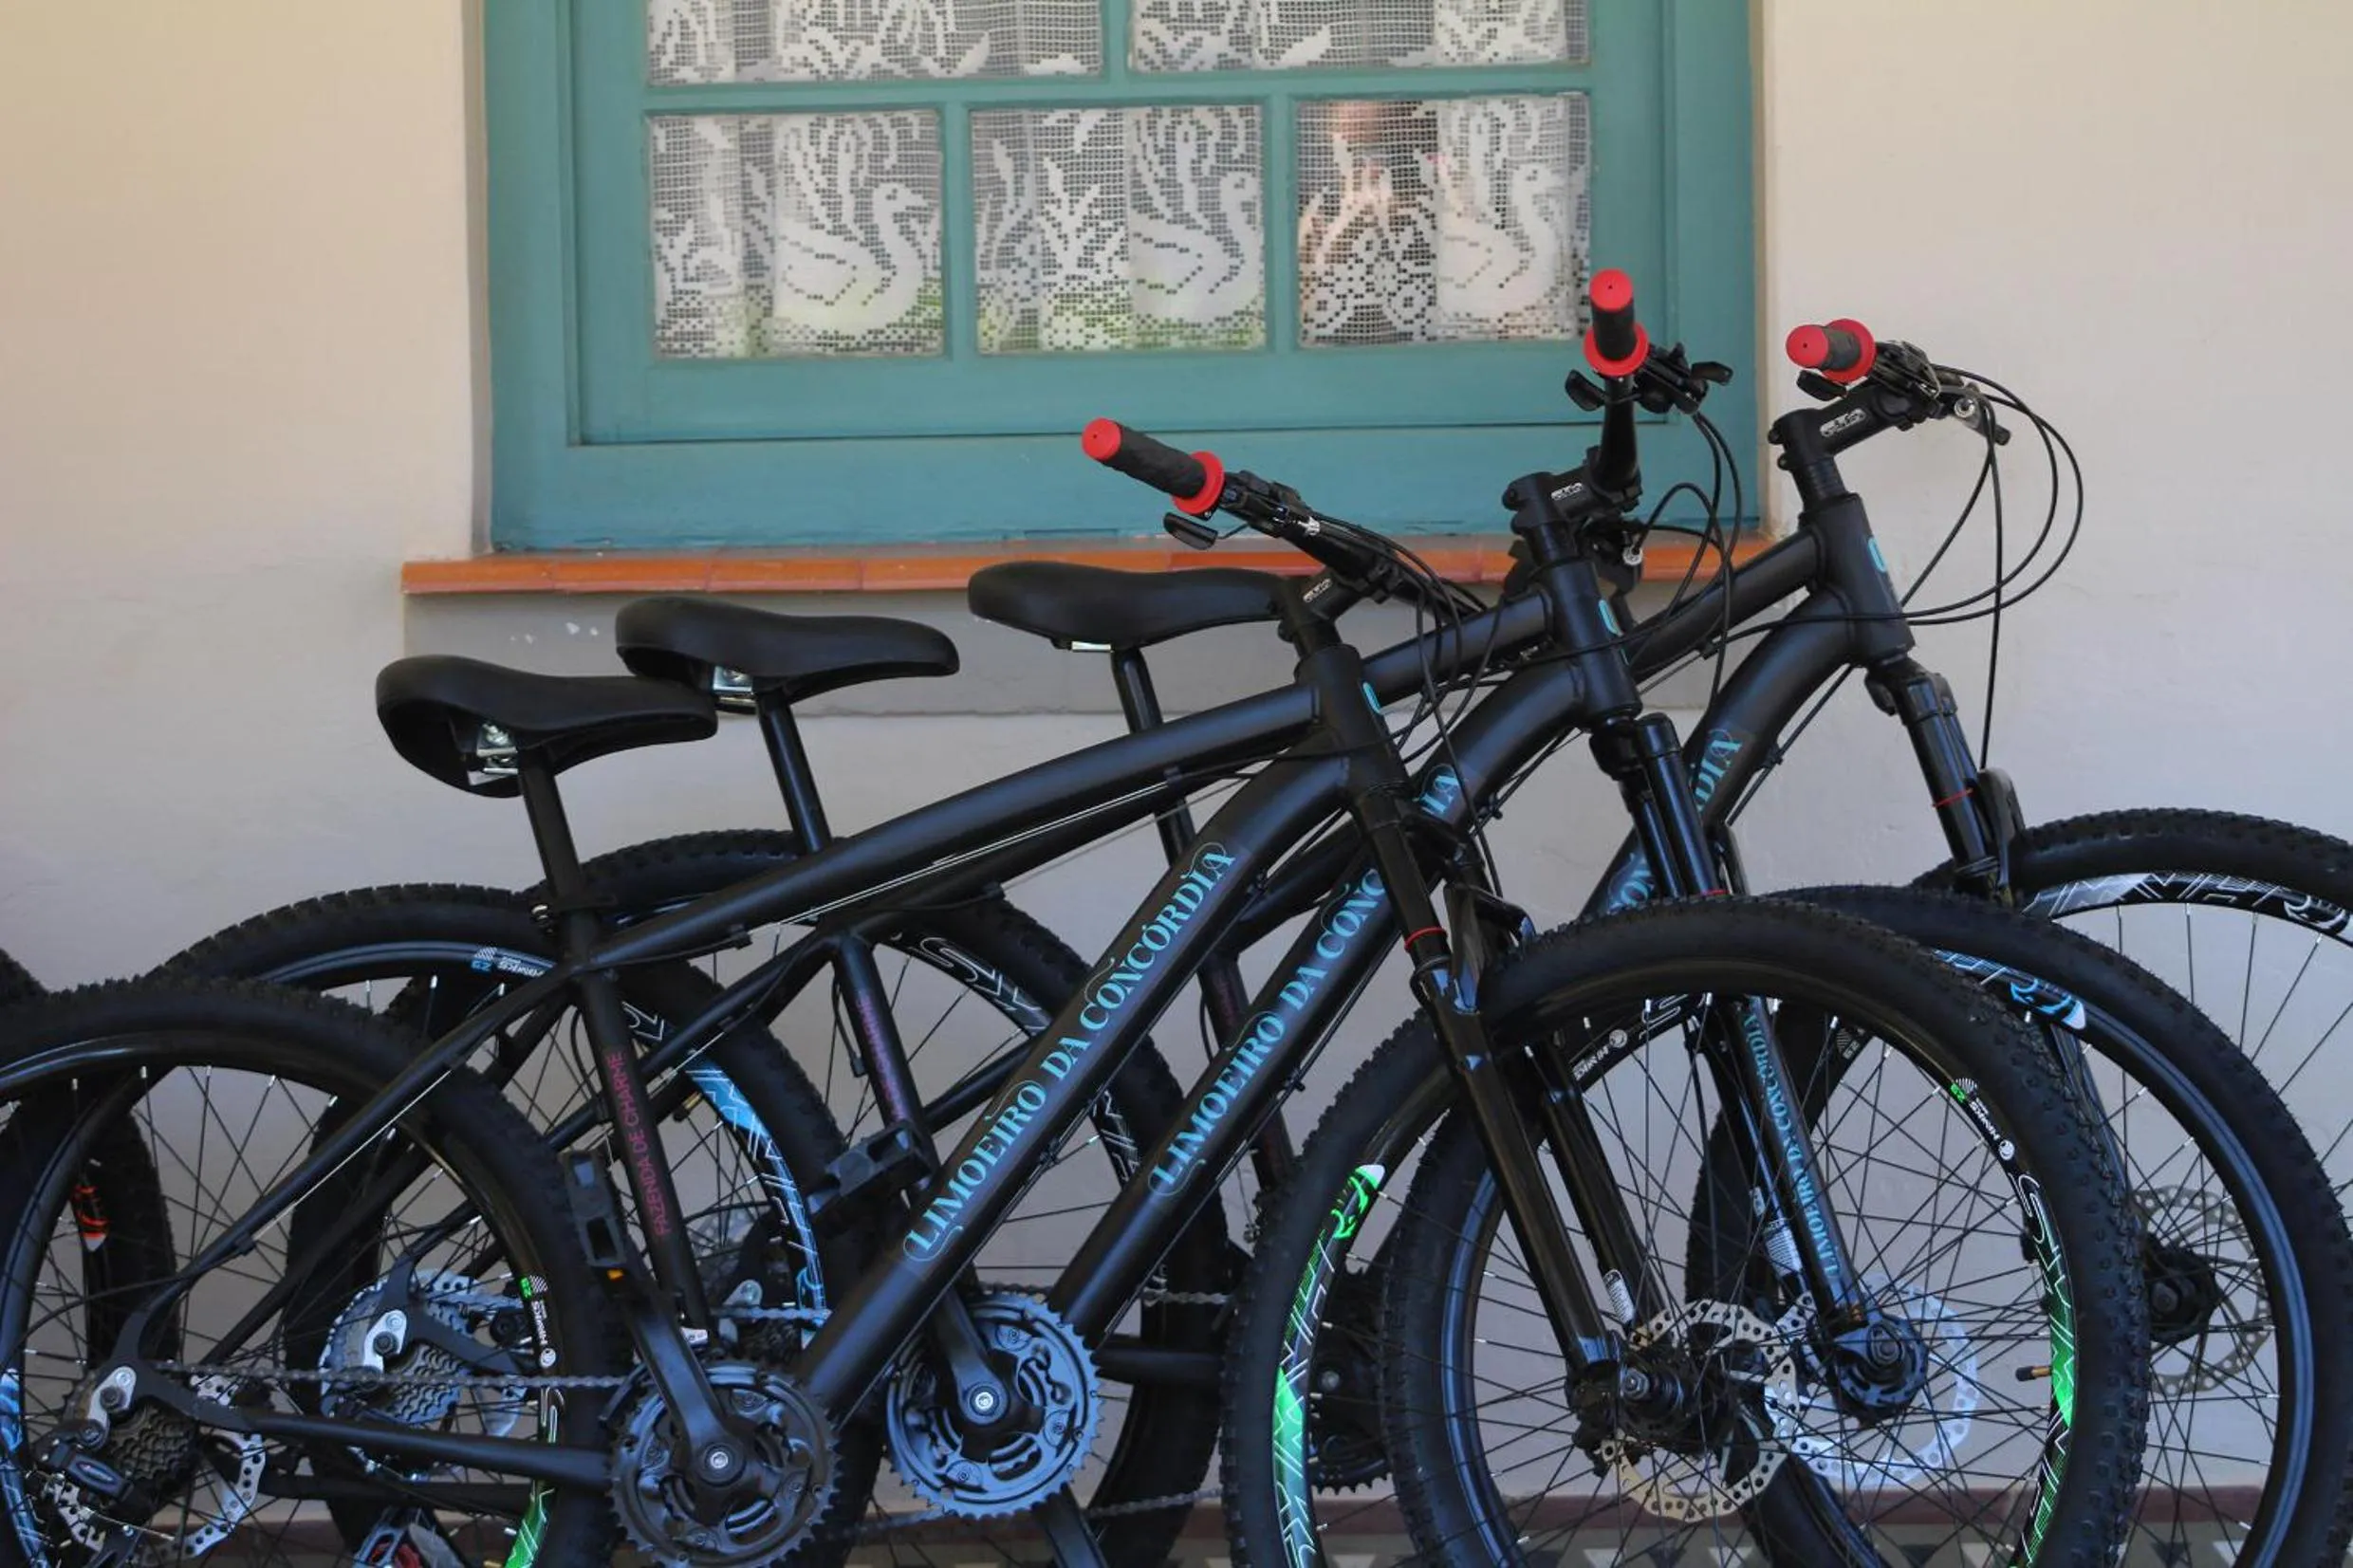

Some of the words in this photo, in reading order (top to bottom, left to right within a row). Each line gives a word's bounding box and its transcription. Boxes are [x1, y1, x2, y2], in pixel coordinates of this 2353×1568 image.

[903, 1079, 1047, 1262] LIMOEIRO
[1041, 1035, 1091, 1081] DA
[1079, 842, 1235, 1032] CONCÓRDIA
[1148, 1011, 1287, 1196] LIMOEIRO
[1280, 965, 1328, 1011] DA
[628, 1129, 649, 1153] DE
[636, 1154, 673, 1235] FAZENDA
